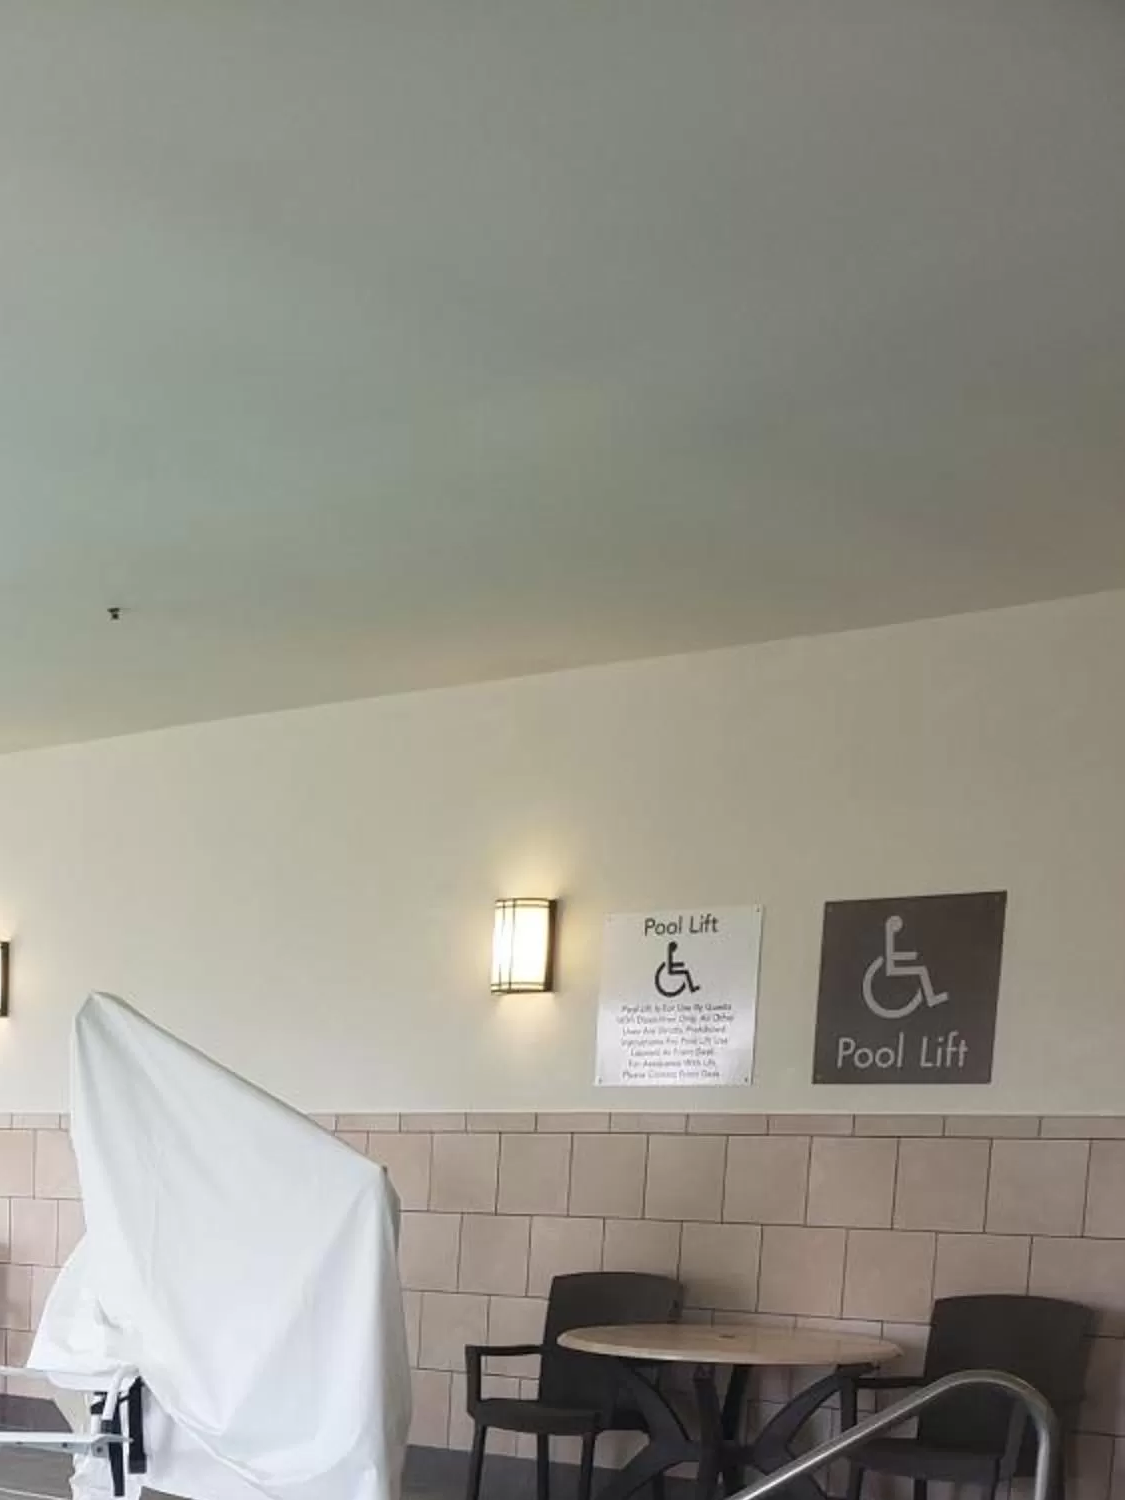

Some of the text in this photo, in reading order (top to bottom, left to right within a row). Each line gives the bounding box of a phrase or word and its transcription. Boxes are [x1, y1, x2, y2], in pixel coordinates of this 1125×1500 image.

[644, 913, 719, 936] Pool Lift
[837, 1030, 969, 1069] Pool Lift
